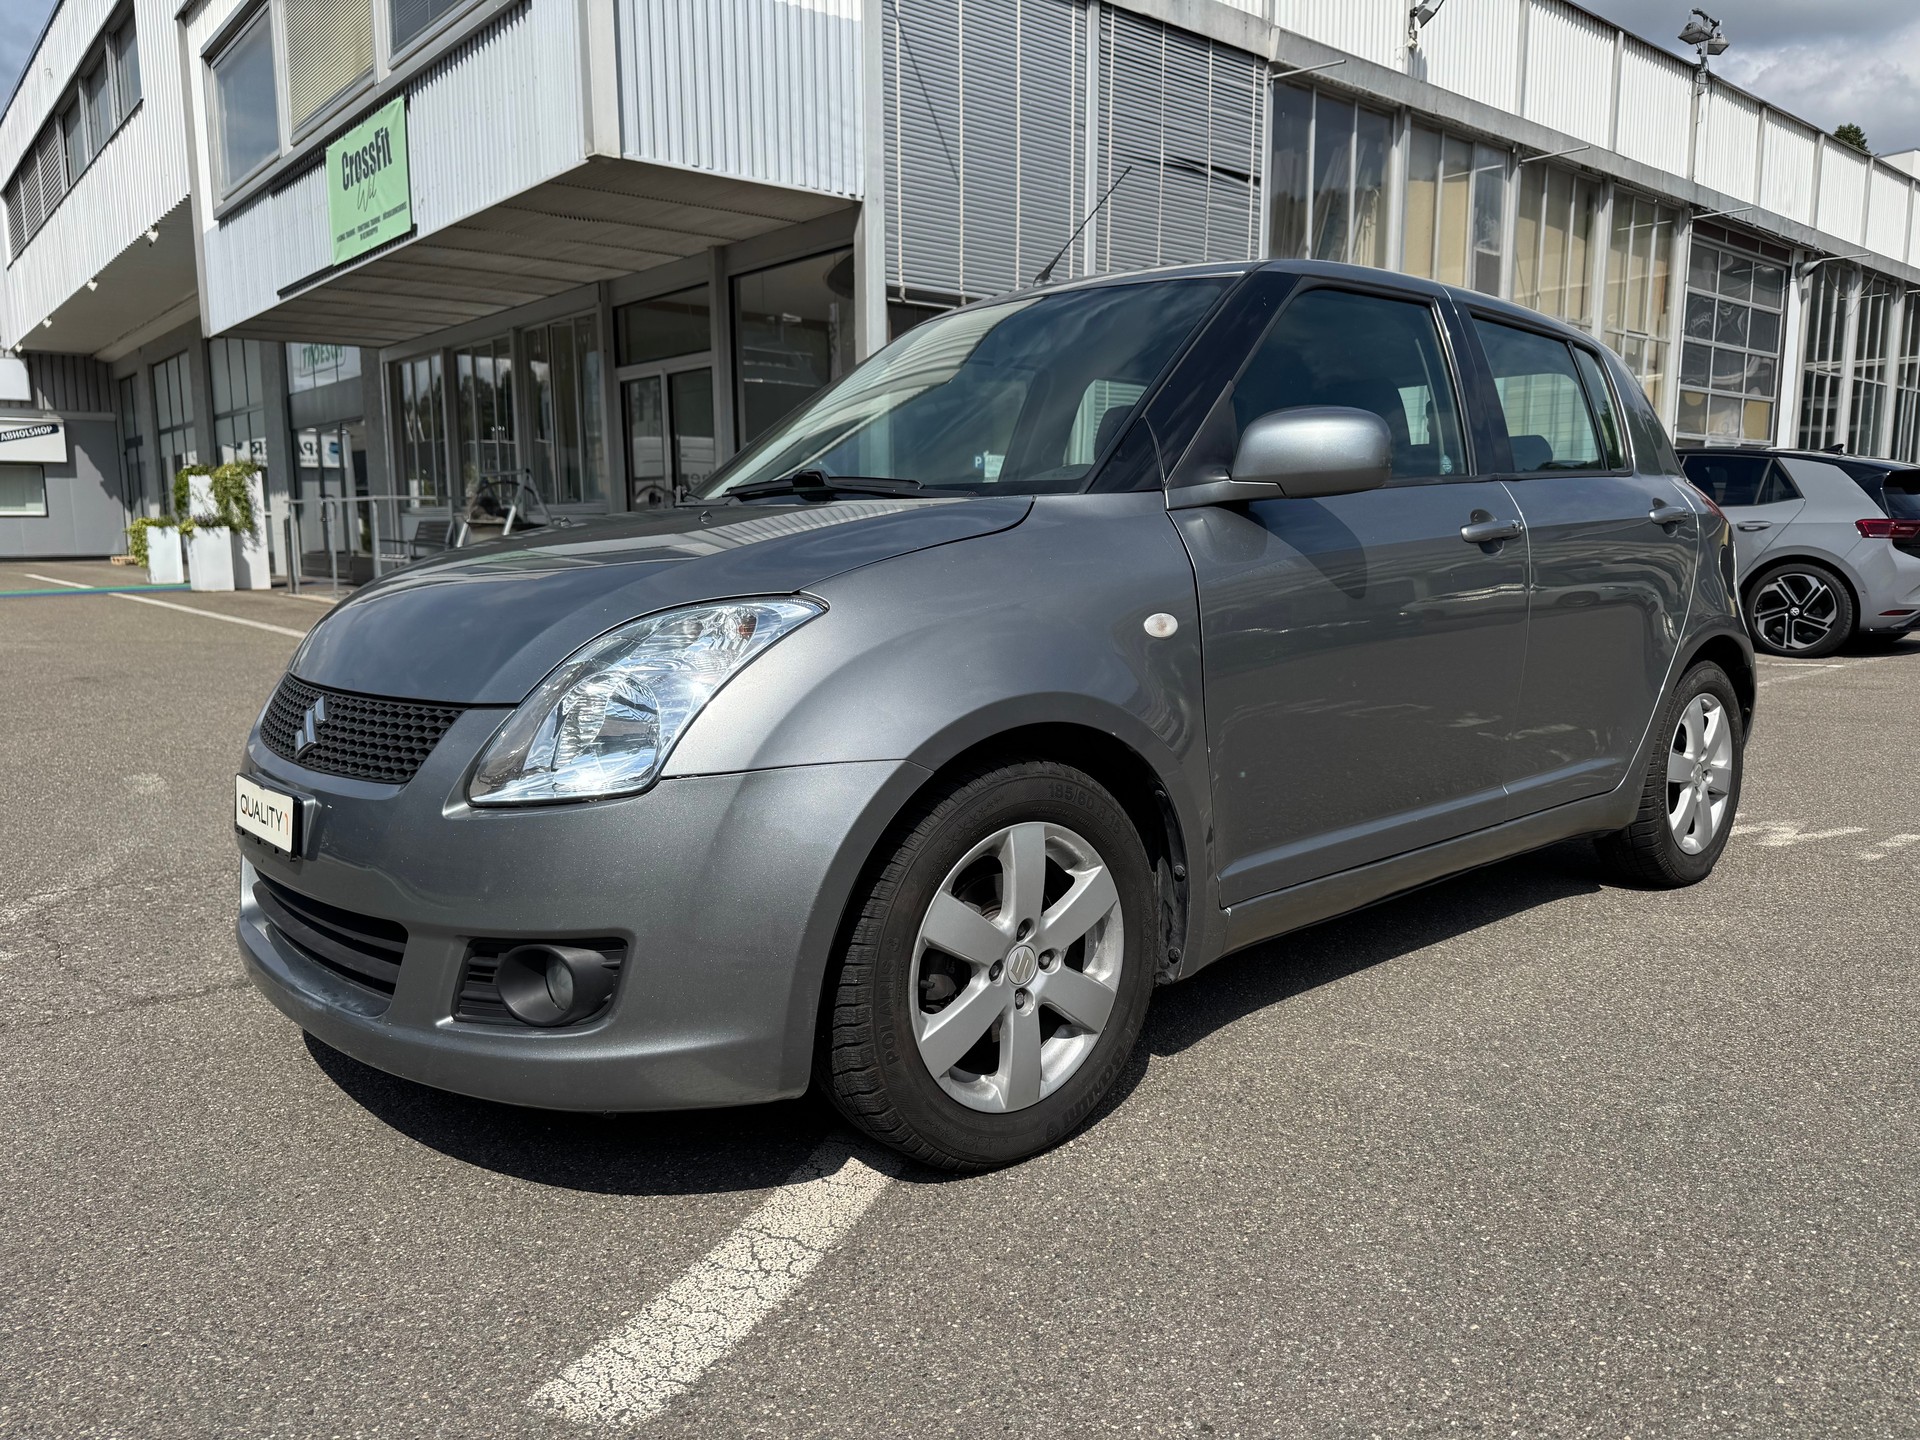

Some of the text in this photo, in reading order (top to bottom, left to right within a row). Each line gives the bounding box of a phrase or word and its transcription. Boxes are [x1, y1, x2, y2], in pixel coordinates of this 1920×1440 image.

[341, 127, 392, 191] CrossFit
[1, 425, 53, 441] ABHOLSHOP
[1048, 782, 1094, 809] 185/60
[880, 961, 900, 1067] POLARIS
